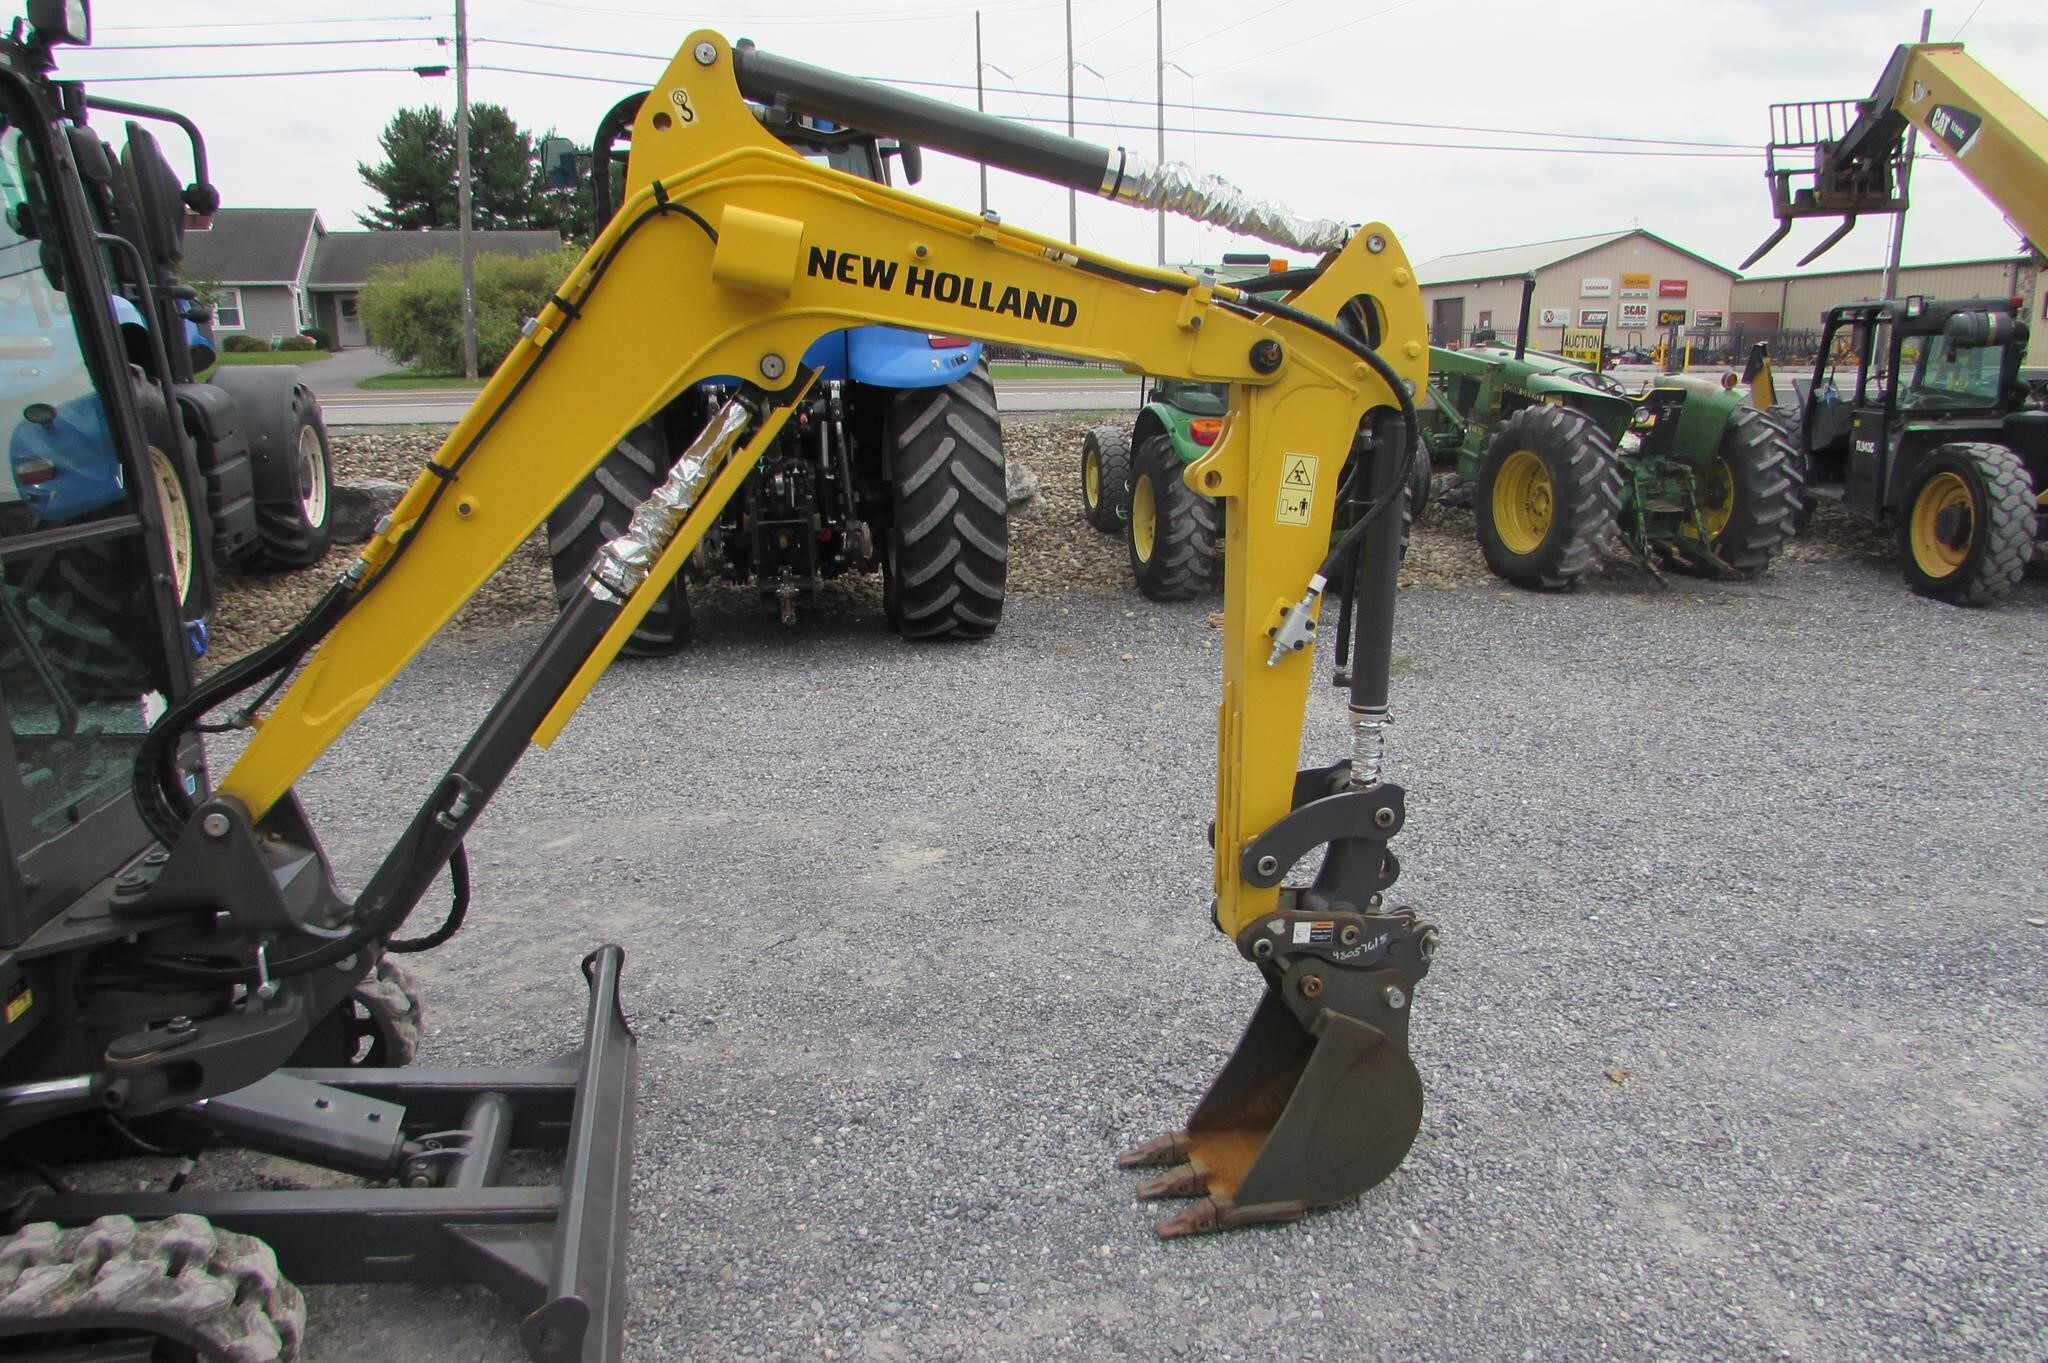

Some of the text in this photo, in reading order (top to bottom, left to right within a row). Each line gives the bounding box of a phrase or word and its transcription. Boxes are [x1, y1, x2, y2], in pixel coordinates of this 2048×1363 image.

[1931, 107, 1951, 137] CAT
[806, 246, 1078, 328] NEW HOLLAND
[1623, 305, 1647, 316] SCAG
[1563, 334, 1601, 349] AUCTION
